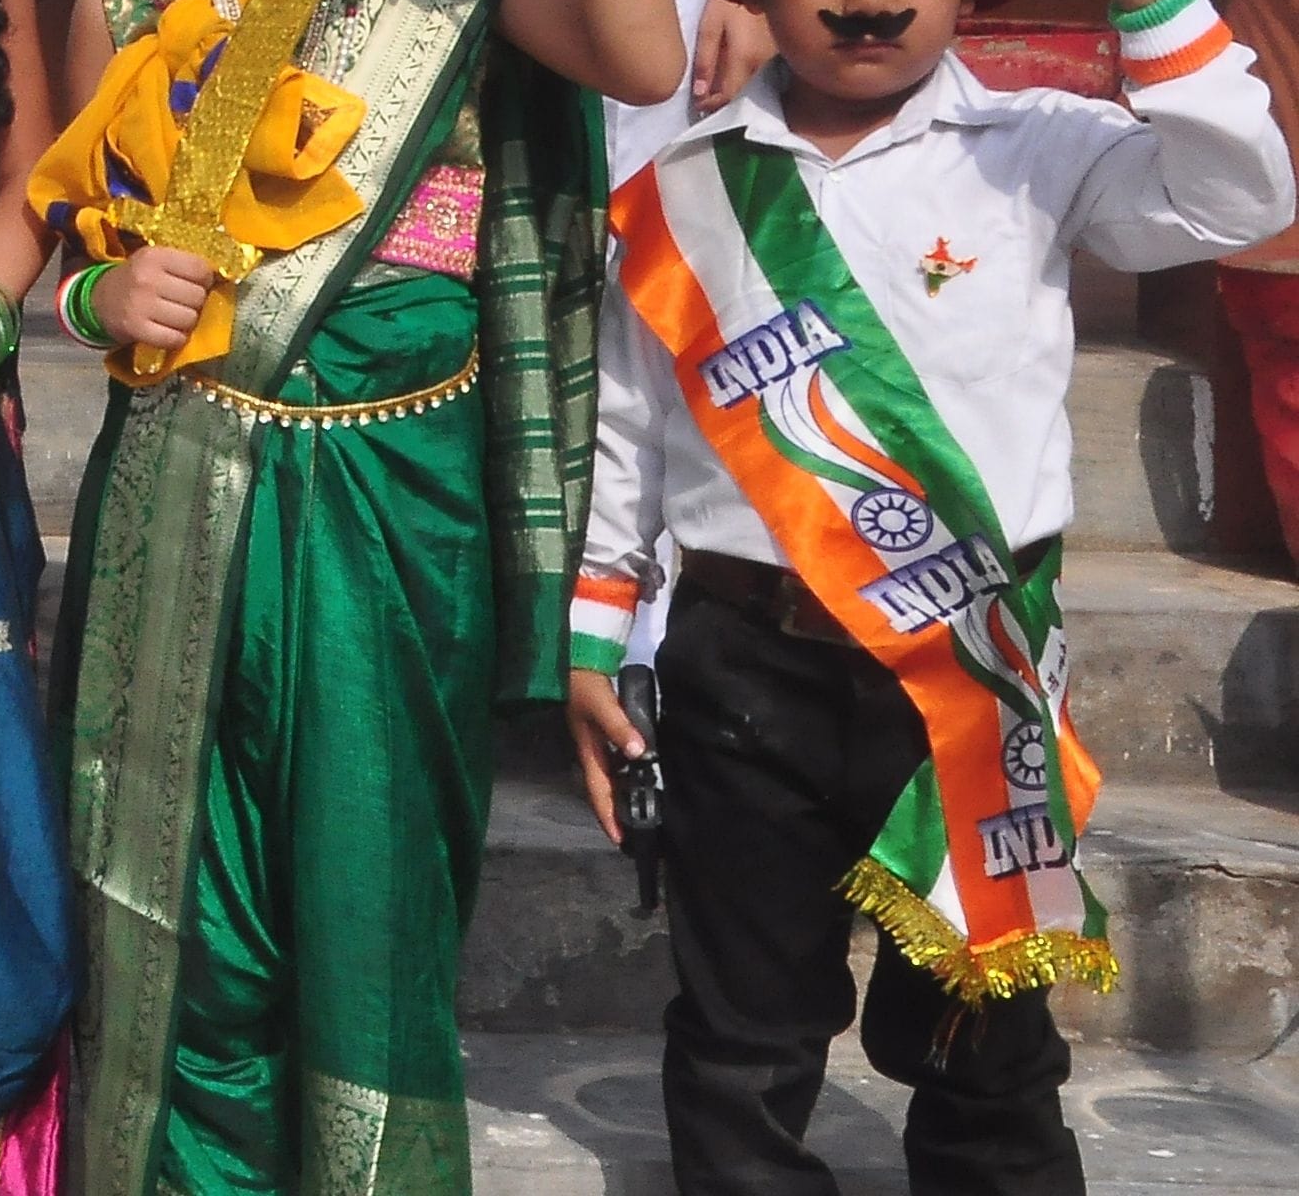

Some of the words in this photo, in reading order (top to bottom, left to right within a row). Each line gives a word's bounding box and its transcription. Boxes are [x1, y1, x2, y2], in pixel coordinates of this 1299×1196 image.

[698, 297, 851, 409] INDIA
[859, 532, 1010, 634] INDIA
[977, 802, 1068, 878] IND
